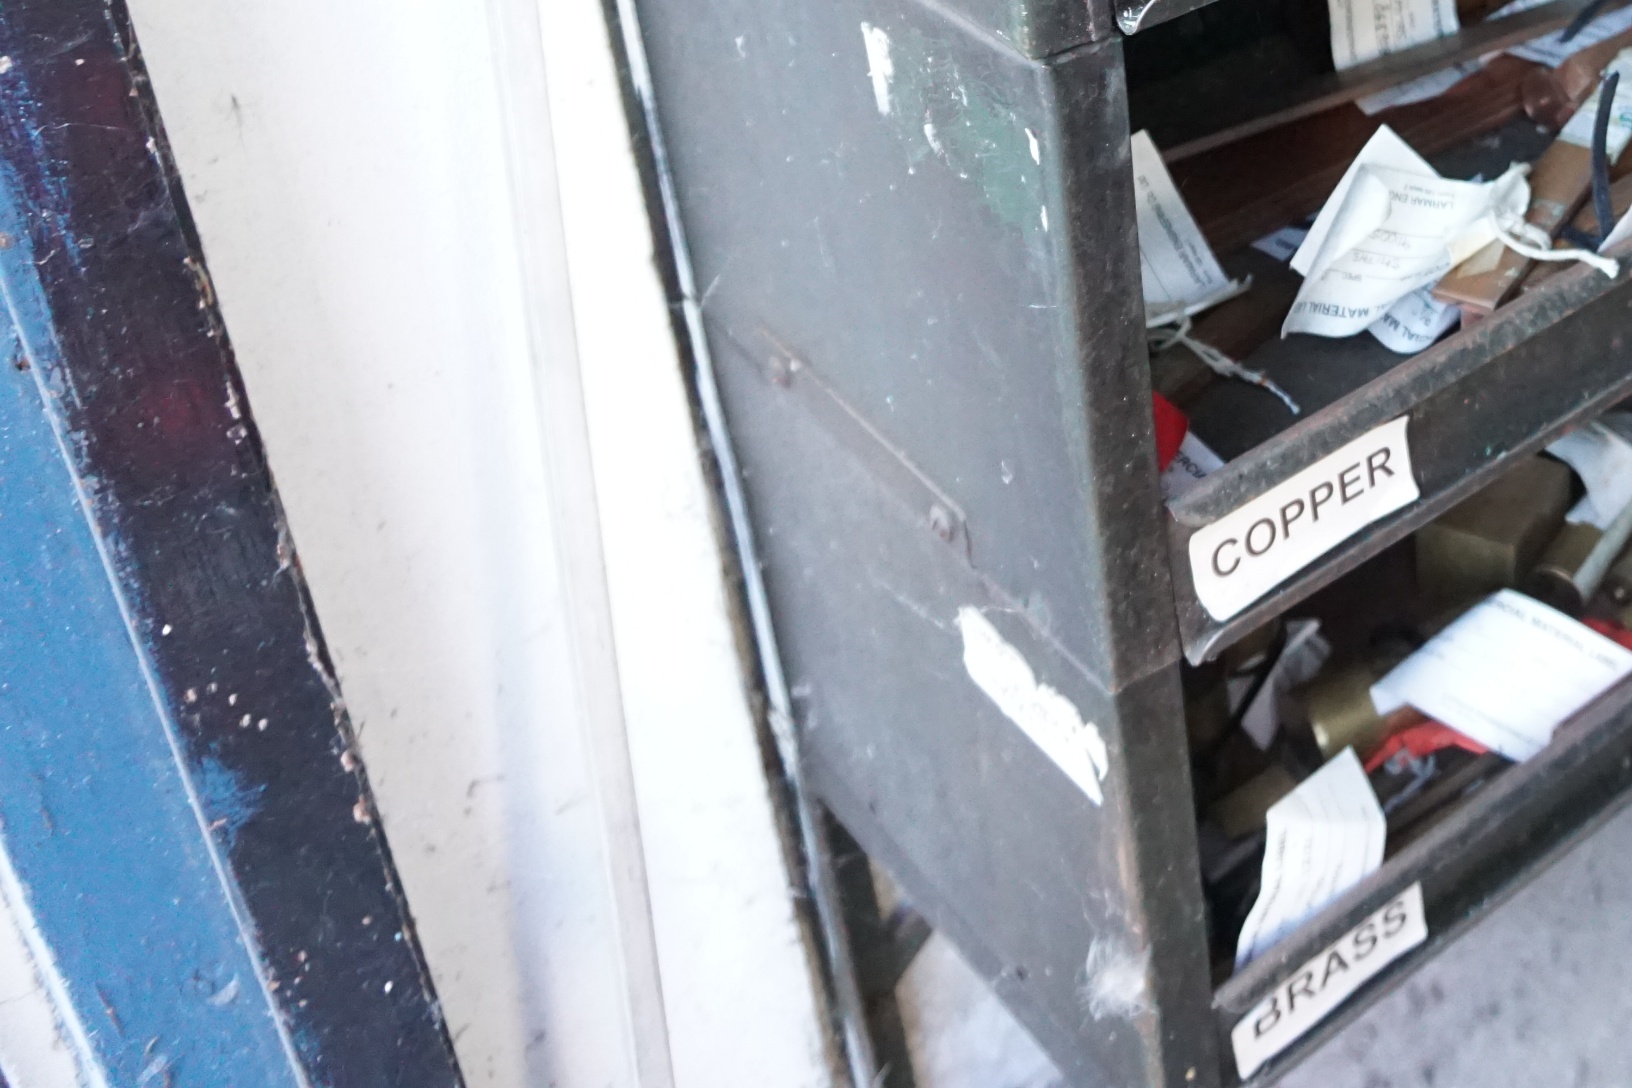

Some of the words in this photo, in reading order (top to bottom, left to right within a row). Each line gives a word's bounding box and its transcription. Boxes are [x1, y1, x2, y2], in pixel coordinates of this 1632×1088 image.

[1308, 302, 1369, 318] MATERIAL
[1383, 313, 1400, 331] MA
[1211, 447, 1395, 578] COPPER
[1253, 900, 1407, 1038] BRASS
